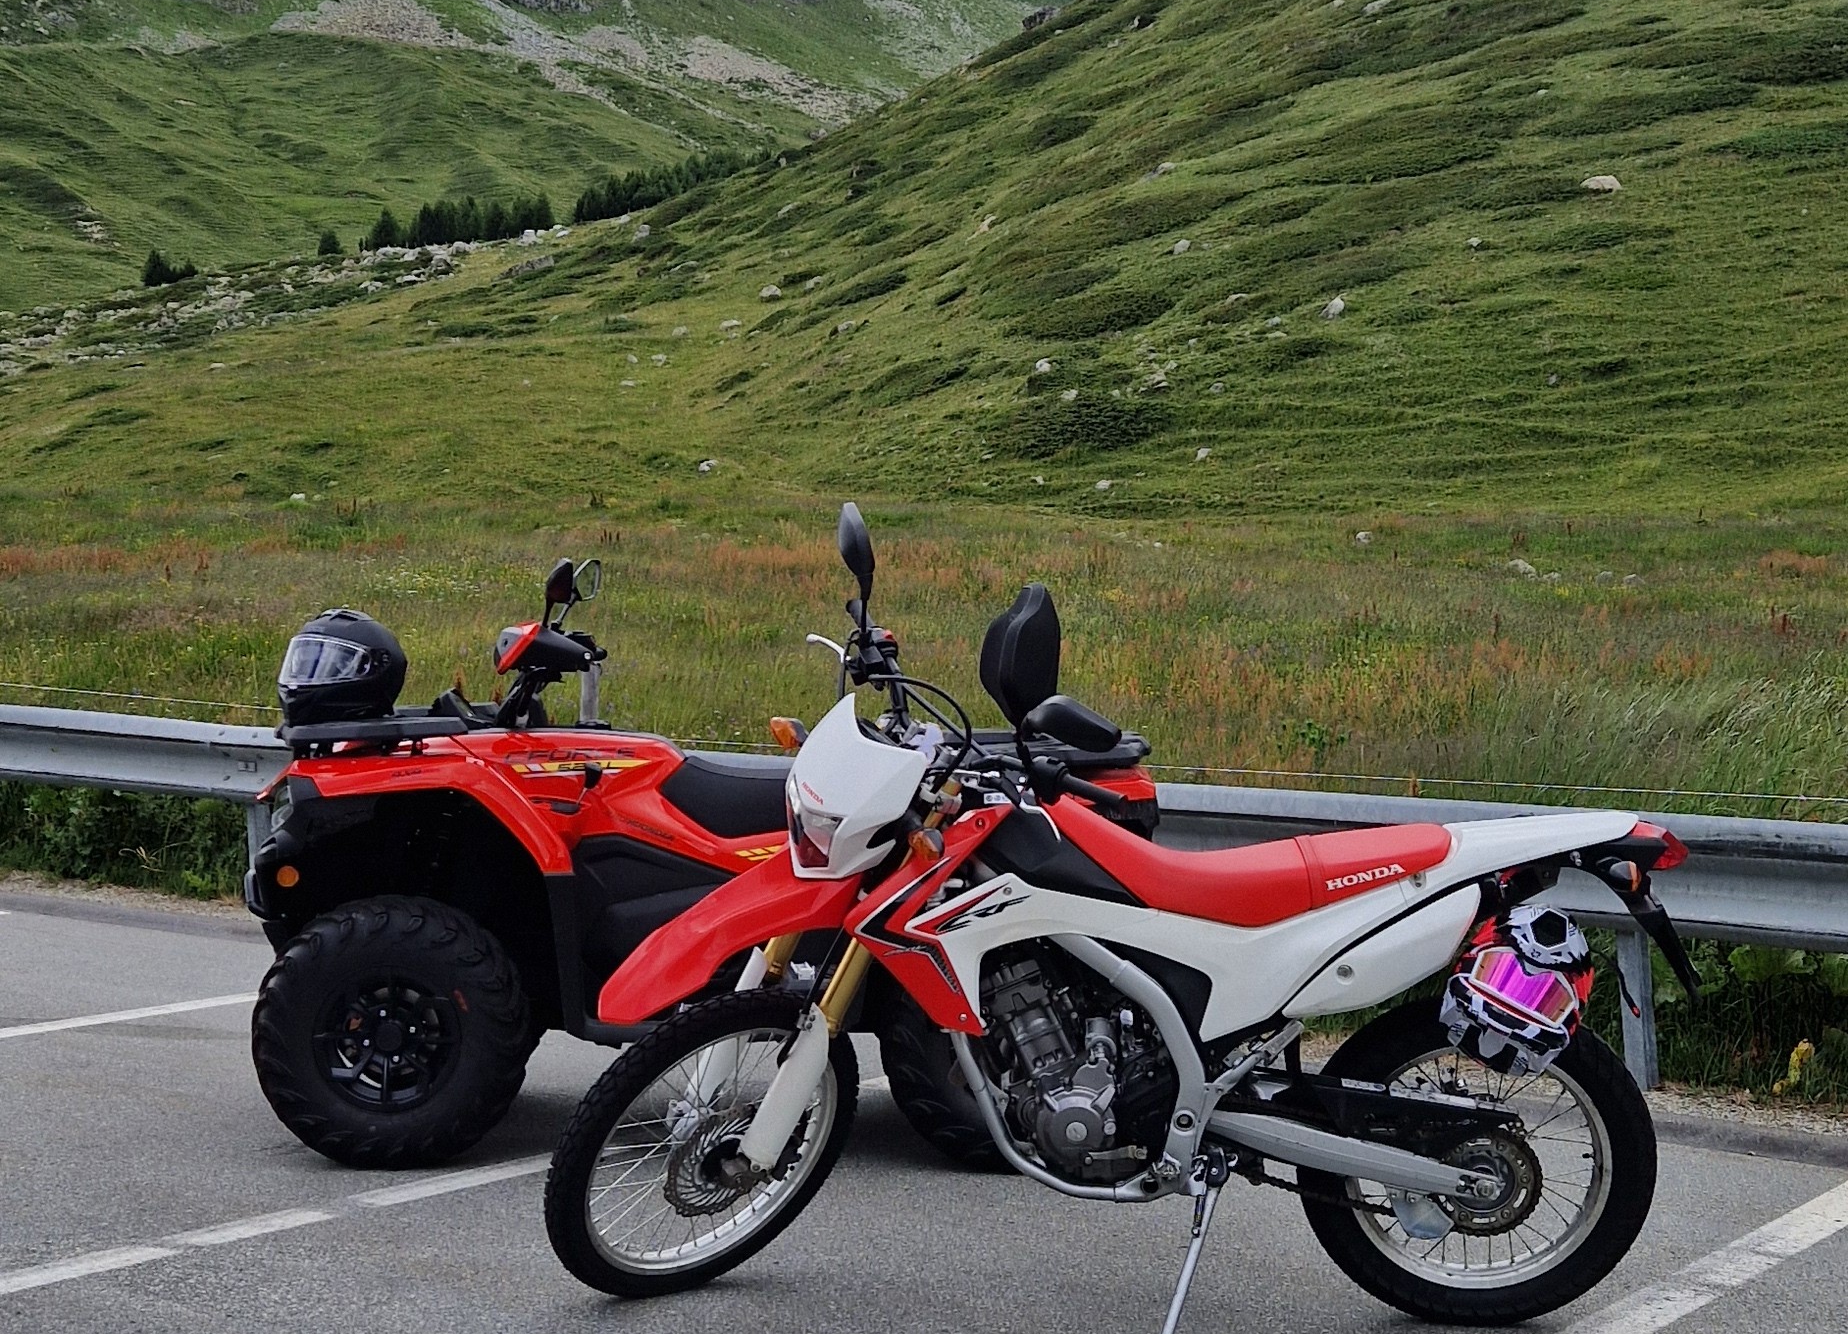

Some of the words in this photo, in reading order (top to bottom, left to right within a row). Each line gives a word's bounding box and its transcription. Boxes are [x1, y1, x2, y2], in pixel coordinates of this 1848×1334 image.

[558, 761, 602, 772] 52
[802, 781, 824, 806] HONDA
[1325, 863, 1406, 891] HONDA
[936, 895, 1032, 935] CRF
